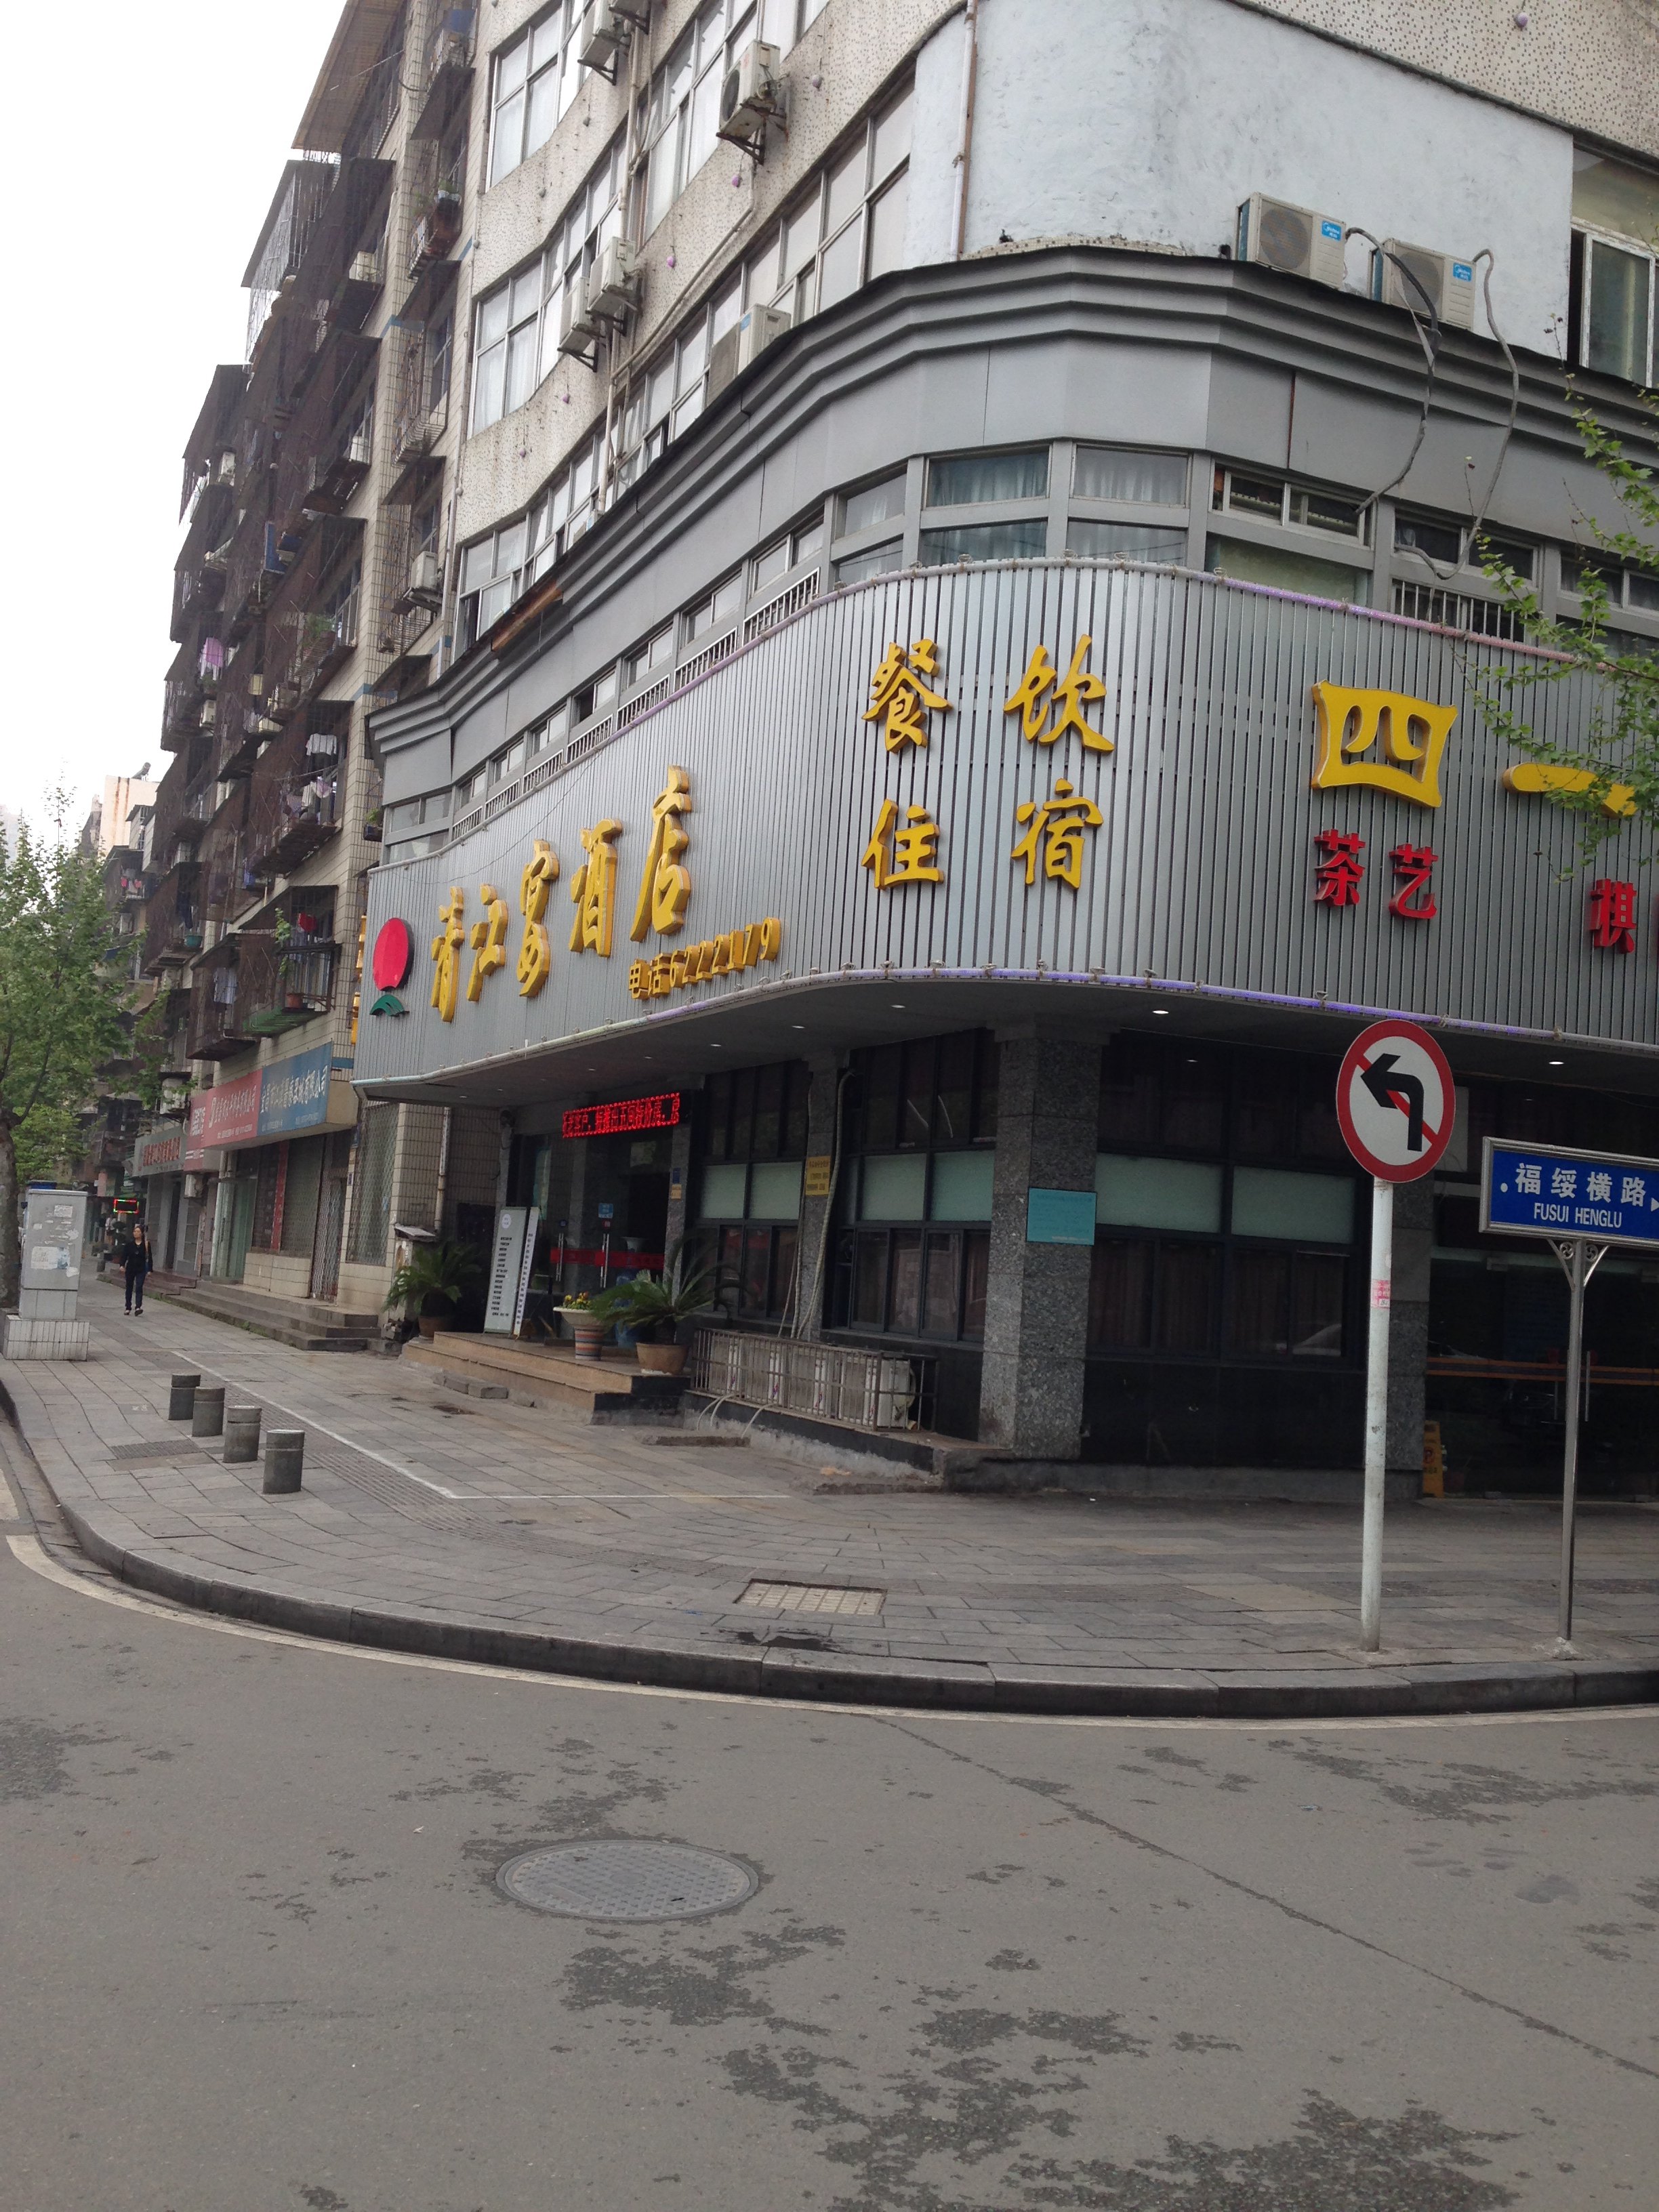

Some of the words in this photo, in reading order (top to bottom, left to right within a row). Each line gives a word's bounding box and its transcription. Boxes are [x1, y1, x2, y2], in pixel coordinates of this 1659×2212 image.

[861, 634, 1115, 754] 餐饮
[861, 777, 1104, 890] 住宿
[1313, 828, 1439, 920] 茶艺
[1590, 878, 1659, 955] 棋
[628, 917, 781, 1000] 电话6222179
[1515, 1163, 1646, 1207] 福绥横路
[1534, 1202, 1569, 1223] FUSUI
[1575, 1207, 1622, 1228] HENGLU
